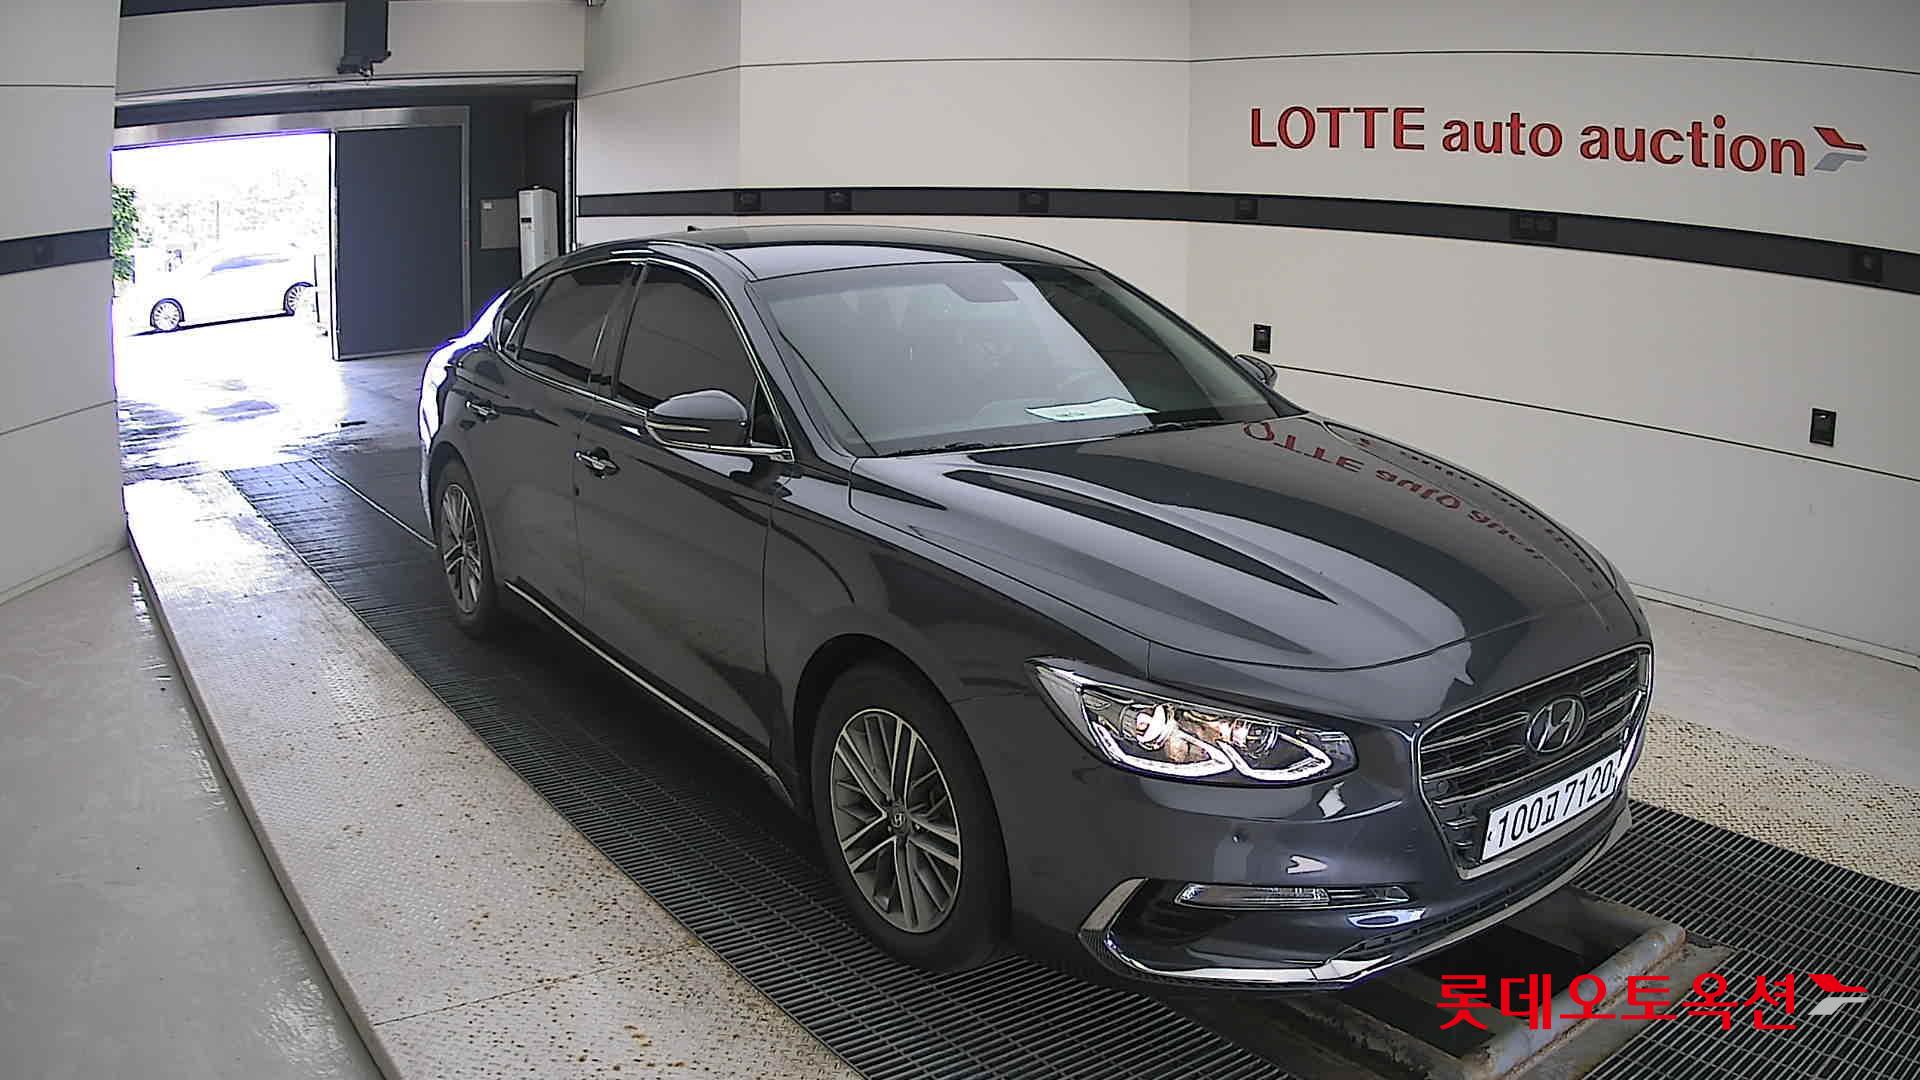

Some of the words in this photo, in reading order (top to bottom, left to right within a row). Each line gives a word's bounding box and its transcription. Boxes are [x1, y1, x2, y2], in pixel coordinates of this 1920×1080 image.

[1250, 106, 1425, 151] LOTTE
[1442, 112, 1563, 158] auto
[1579, 115, 1806, 177] auction
